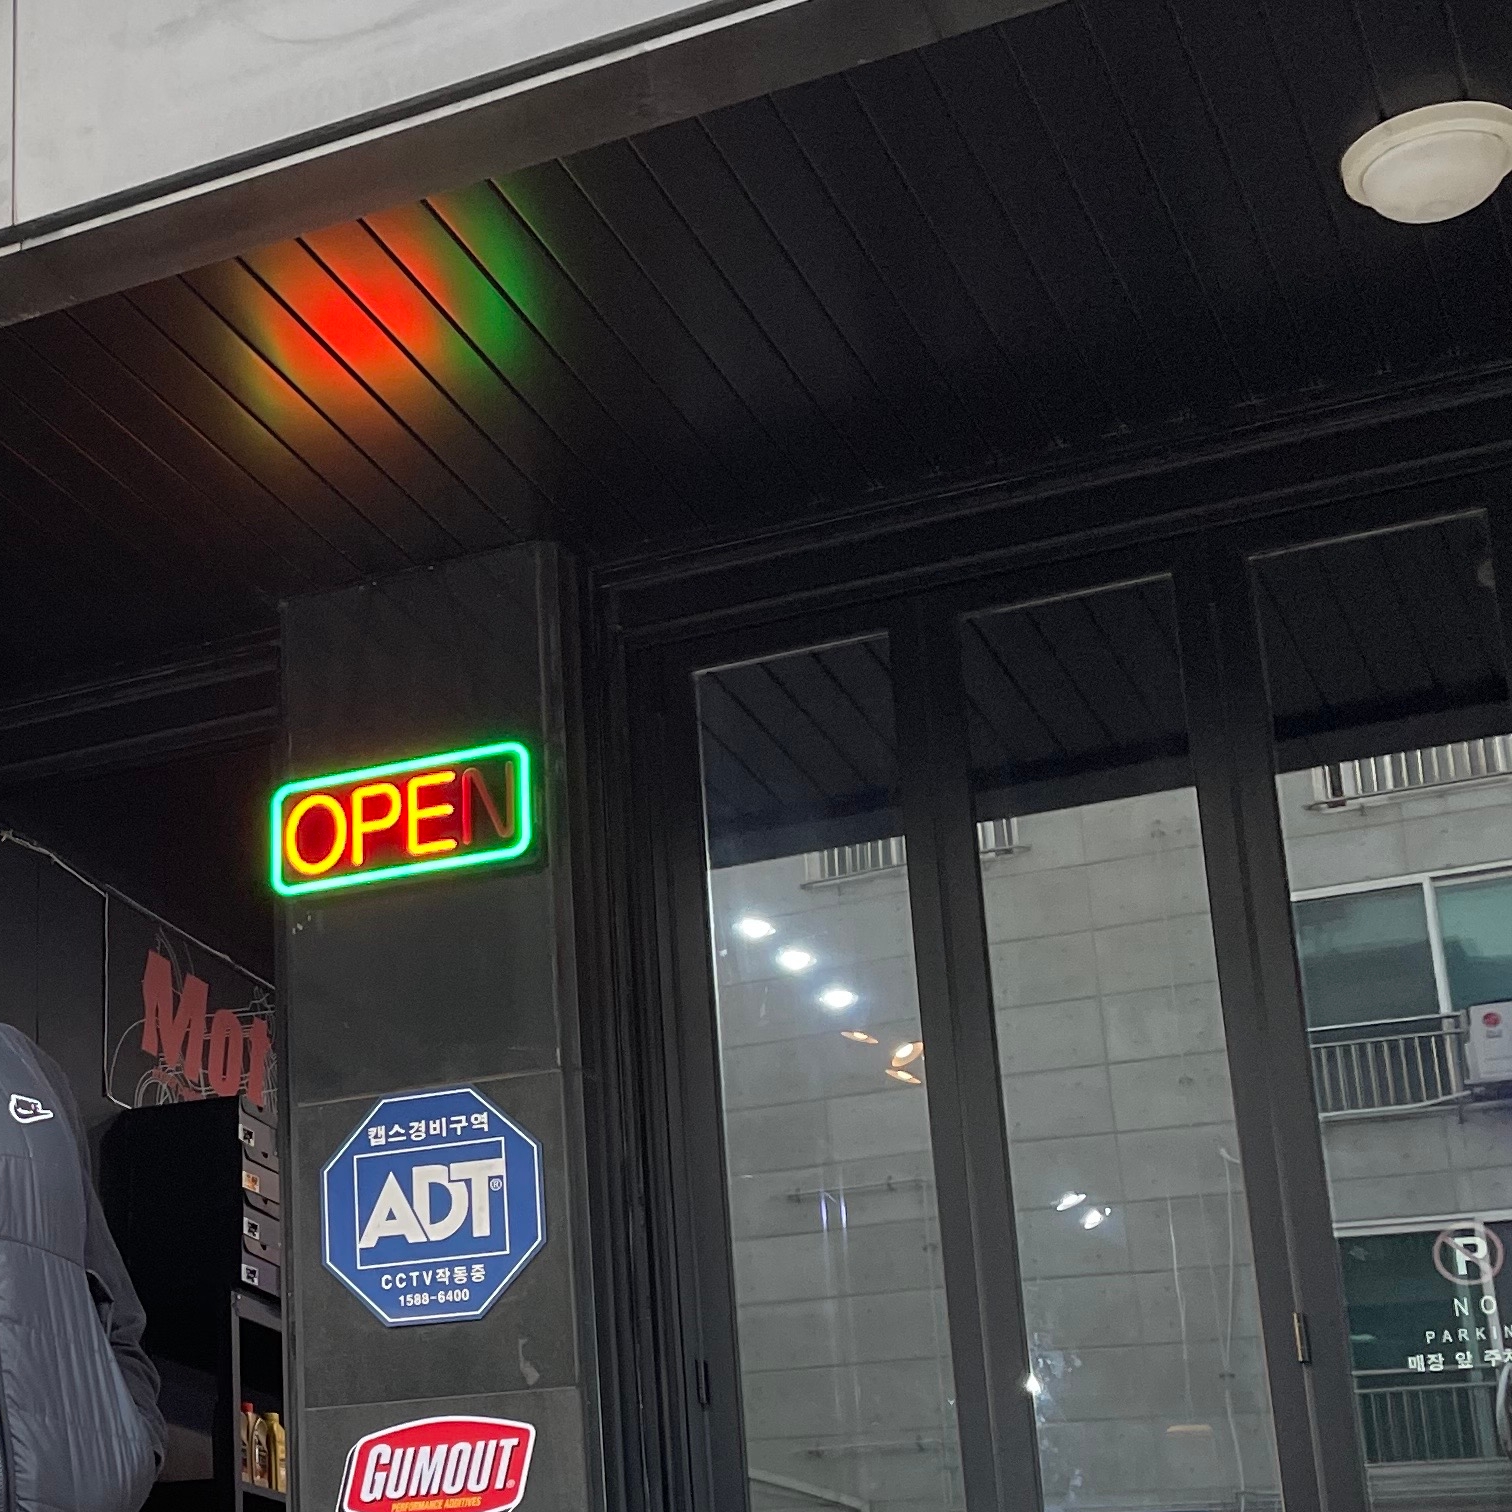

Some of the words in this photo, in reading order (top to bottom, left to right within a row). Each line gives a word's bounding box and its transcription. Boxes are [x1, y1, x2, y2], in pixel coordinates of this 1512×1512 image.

[285, 760, 515, 876] OPEN
[358, 1157, 506, 1249] ADT
[398, 1288, 471, 1307] 1588-6400
[1453, 1295, 1497, 1317] NO
[1407, 1352, 1445, 1373] 매장
[359, 1437, 521, 1504] GUMOUT
[390, 1499, 443, 1512] PERFORMANCE
[444, 1496, 483, 1509] ADDITIVES
